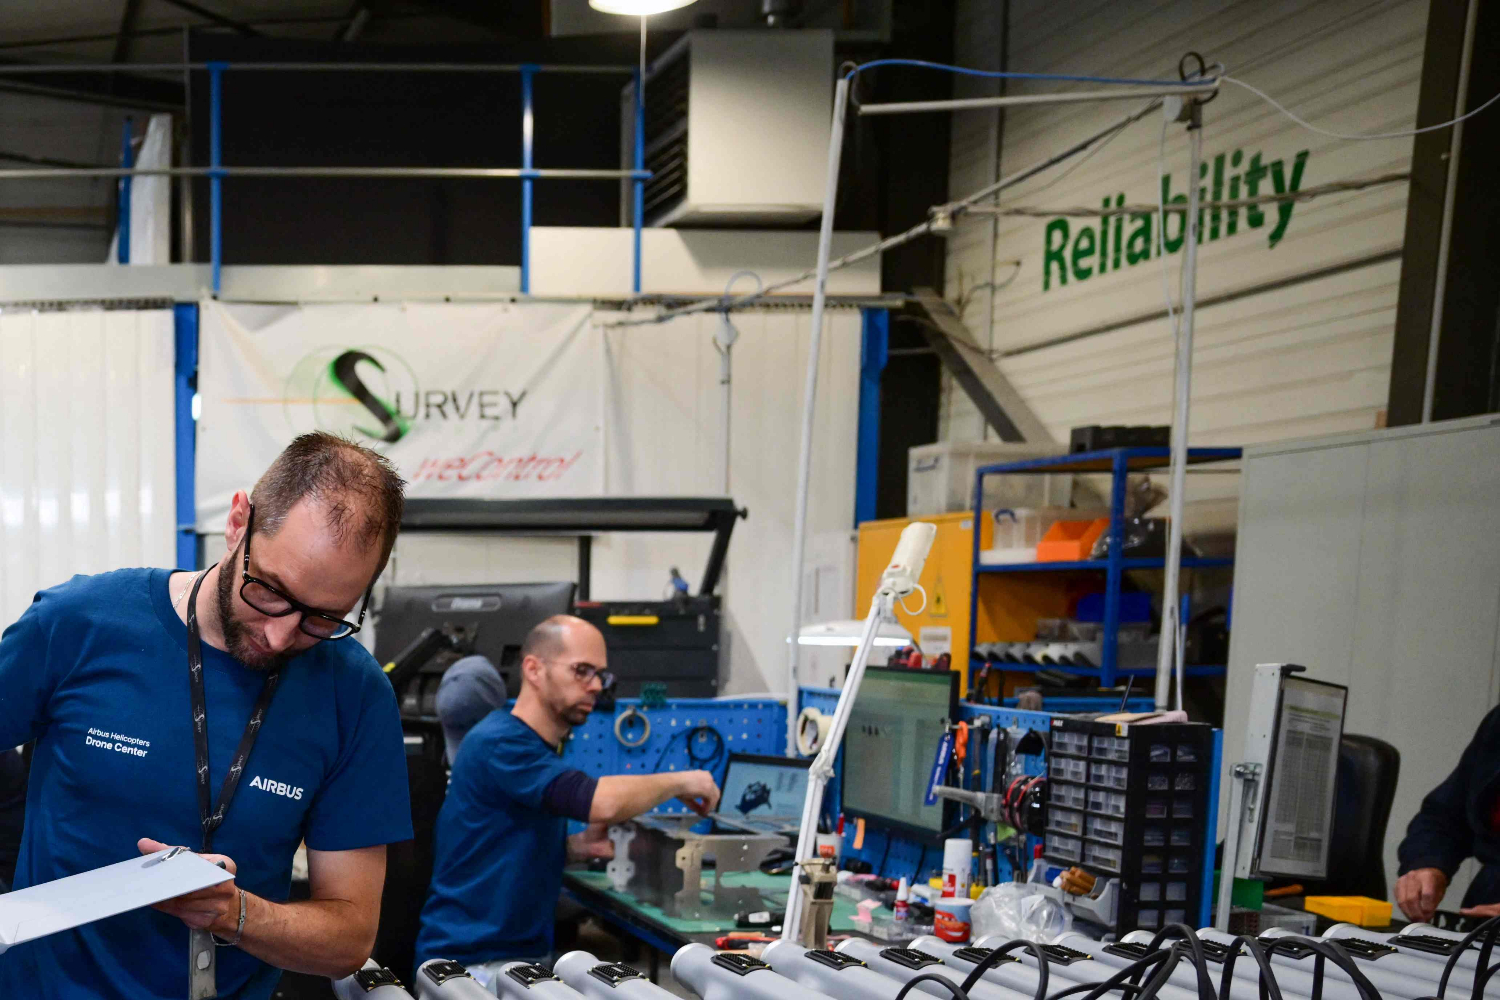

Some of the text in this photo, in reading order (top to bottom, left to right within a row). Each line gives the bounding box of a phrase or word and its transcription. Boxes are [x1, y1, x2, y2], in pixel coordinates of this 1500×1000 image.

[1042, 148, 1310, 292] Reliability
[329, 349, 529, 444] SURVEY
[85, 735, 148, 758] Drone Center
[87, 727, 150, 747] Airbus Helicopters
[249, 775, 304, 801] AIRBUS
